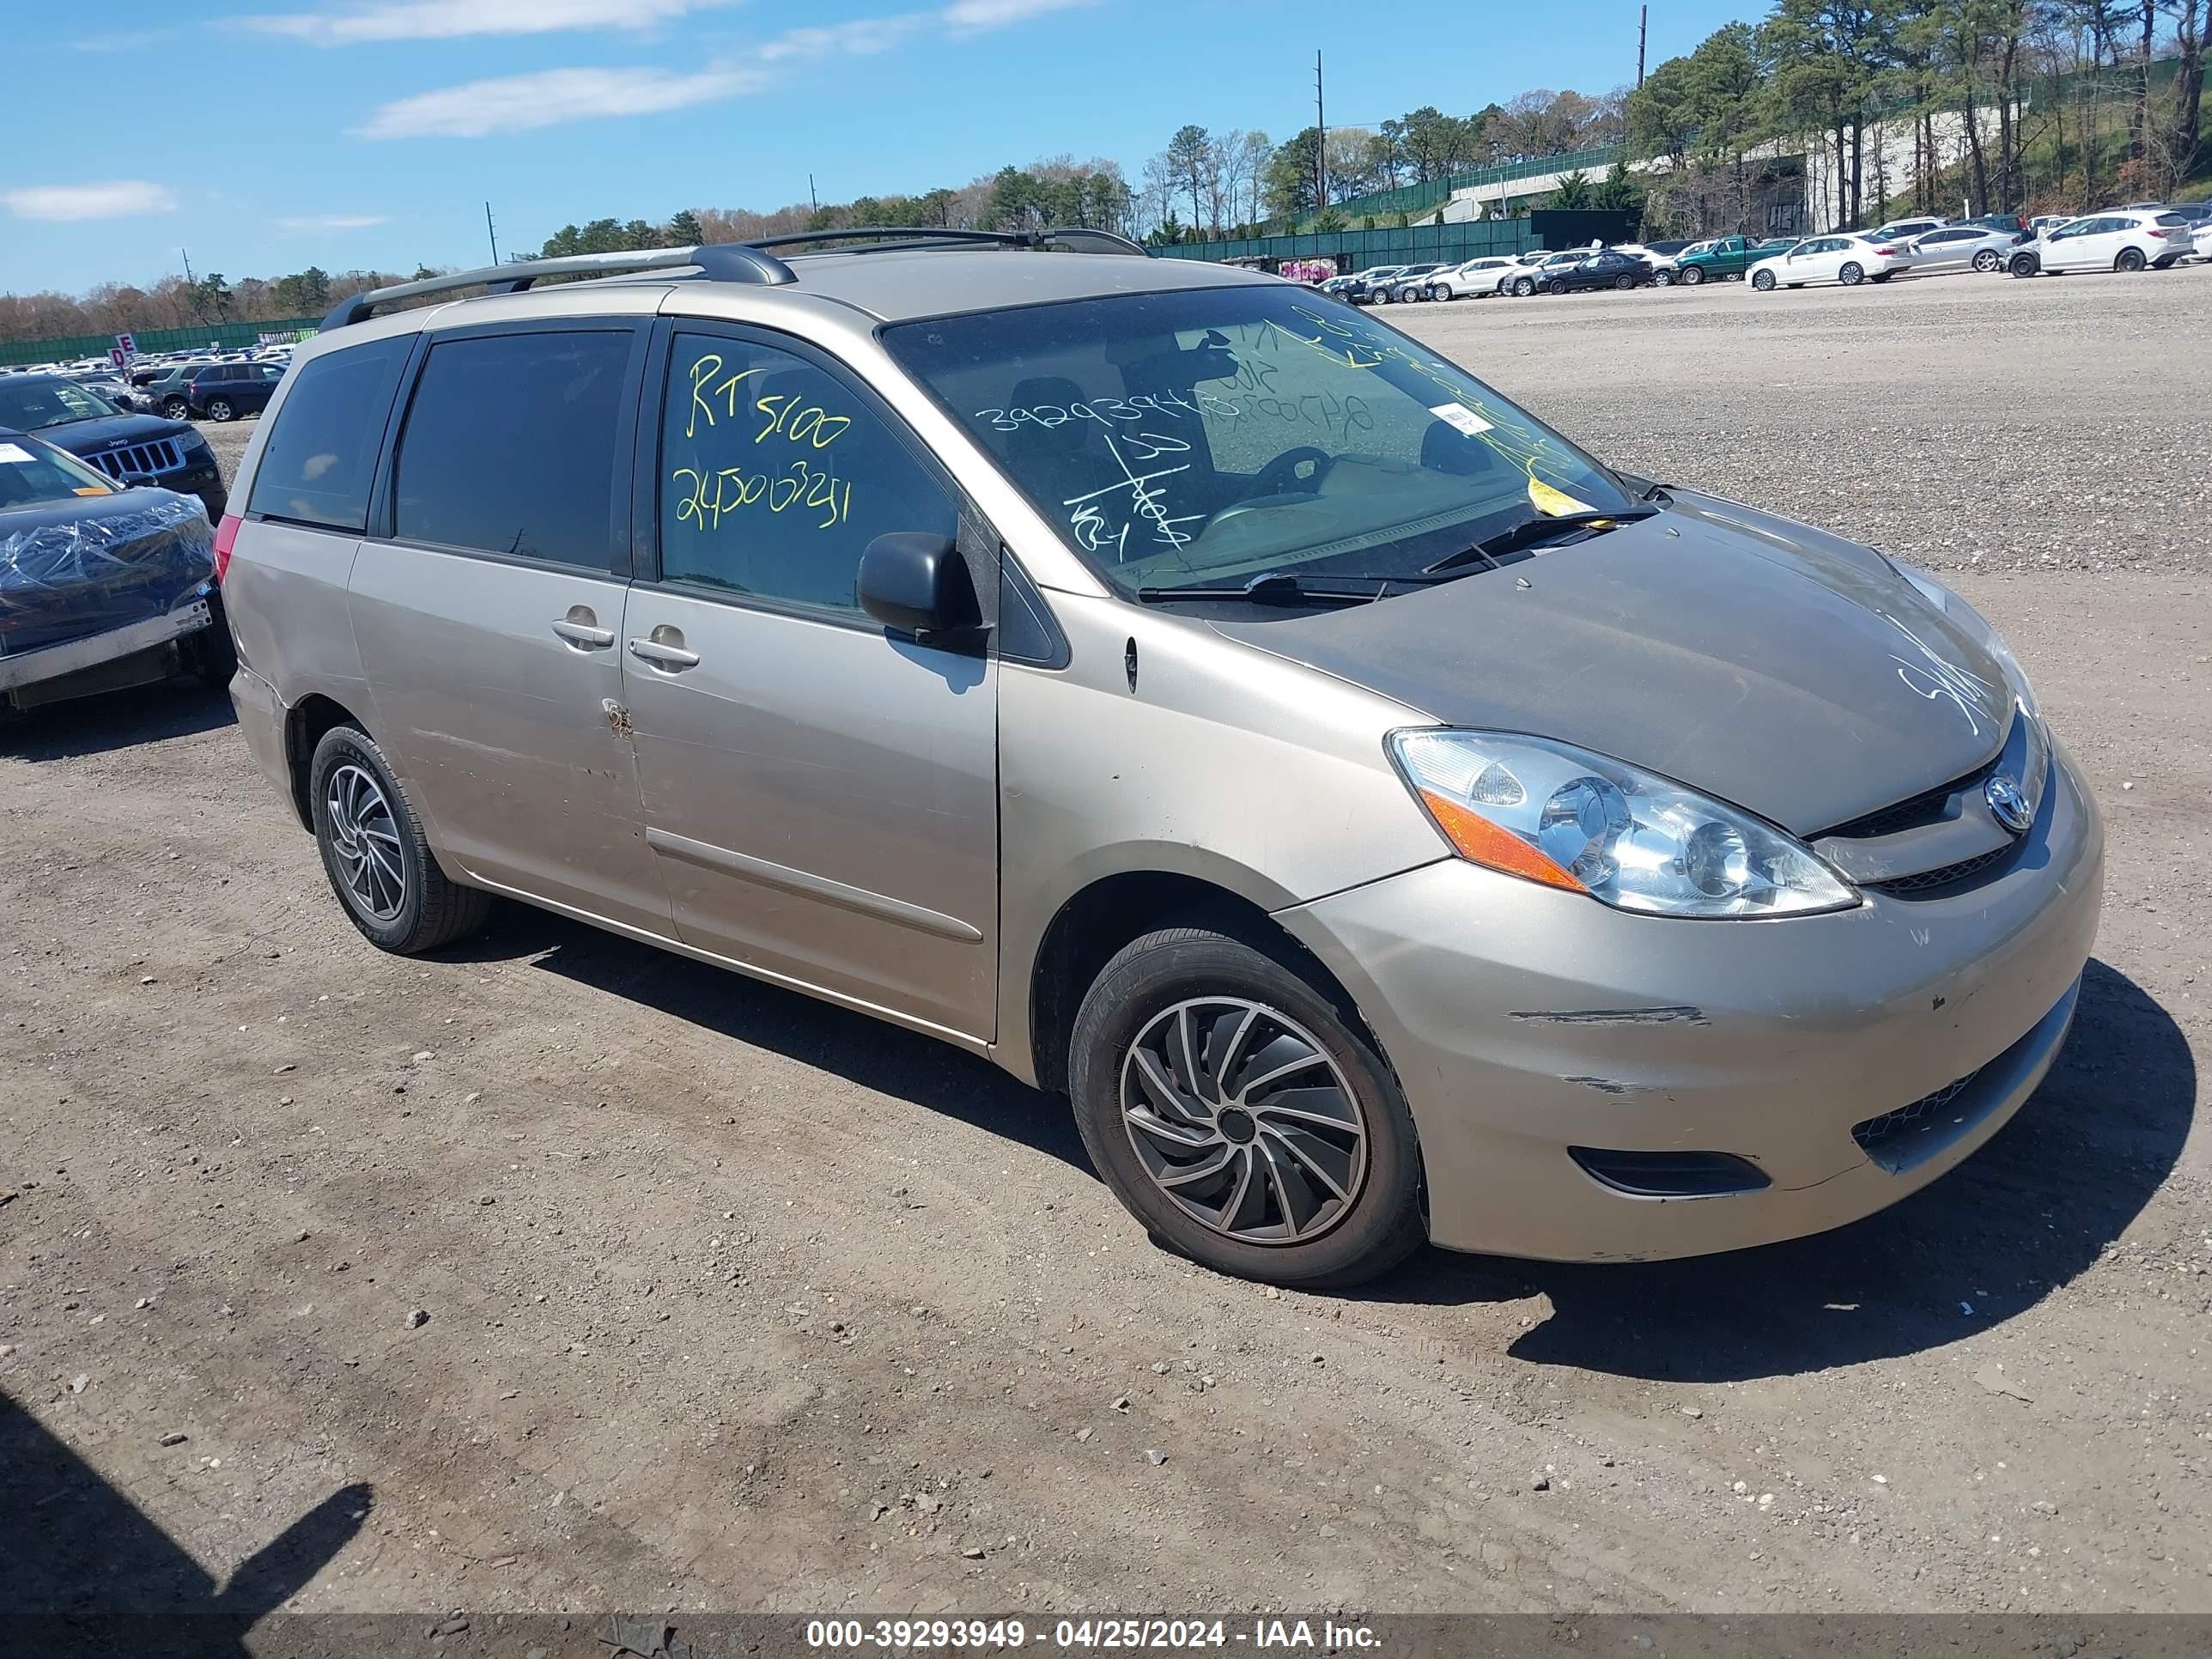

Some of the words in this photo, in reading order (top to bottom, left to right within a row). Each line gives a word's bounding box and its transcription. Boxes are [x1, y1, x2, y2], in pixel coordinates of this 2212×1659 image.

[112, 349, 125, 367] D
[120, 336, 133, 352] E
[686, 354, 768, 439] RT
[754, 391, 852, 448] 5100
